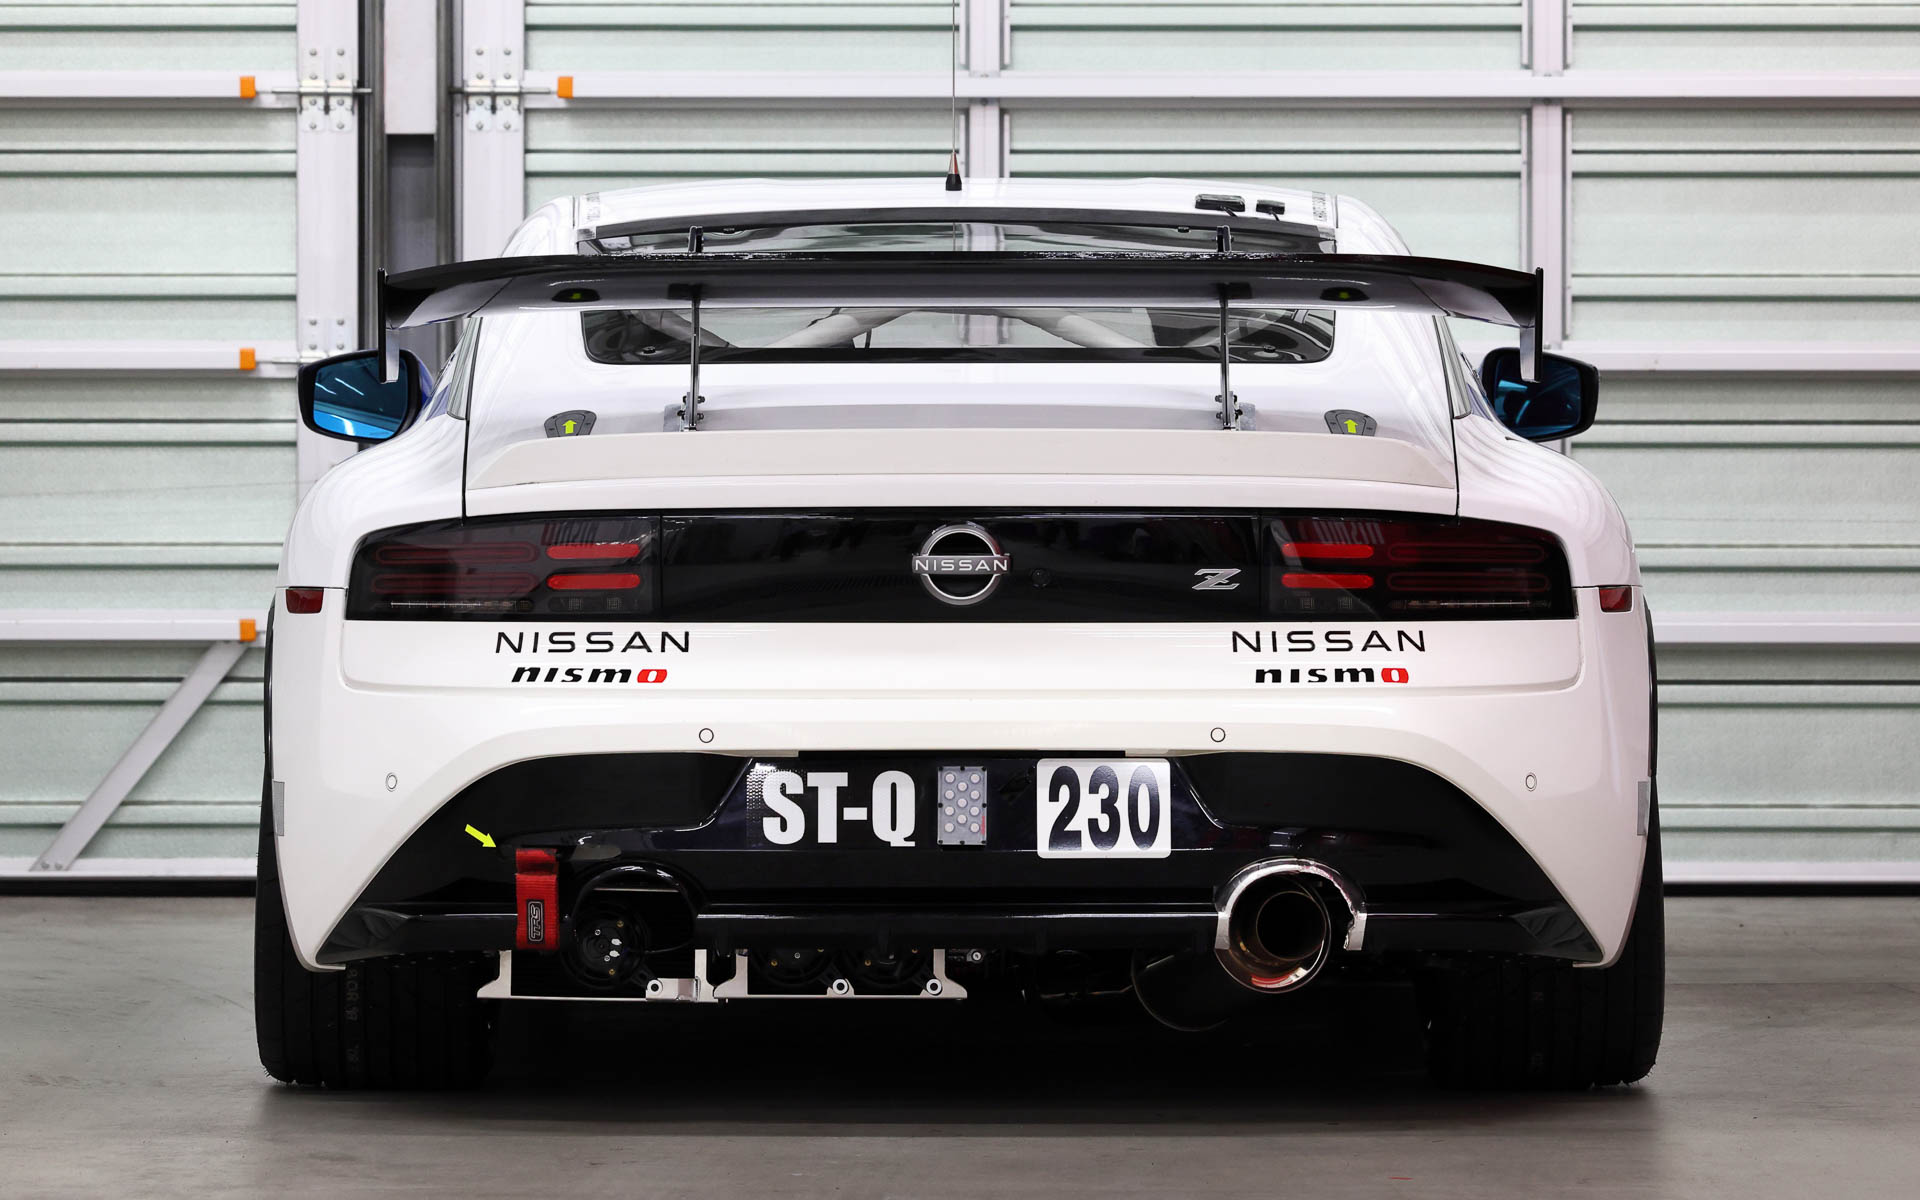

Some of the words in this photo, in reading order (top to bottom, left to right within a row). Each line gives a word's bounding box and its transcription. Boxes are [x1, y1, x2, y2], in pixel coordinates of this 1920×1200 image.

[914, 559, 1008, 571] NISSAN
[1192, 568, 1242, 590] Z
[495, 631, 690, 653] NISSAN
[1232, 630, 1426, 652] NISSAN
[511, 667, 668, 683] nismo
[1255, 667, 1409, 683] nismo
[762, 770, 916, 847] ST-Q
[1048, 765, 1161, 851] 230
